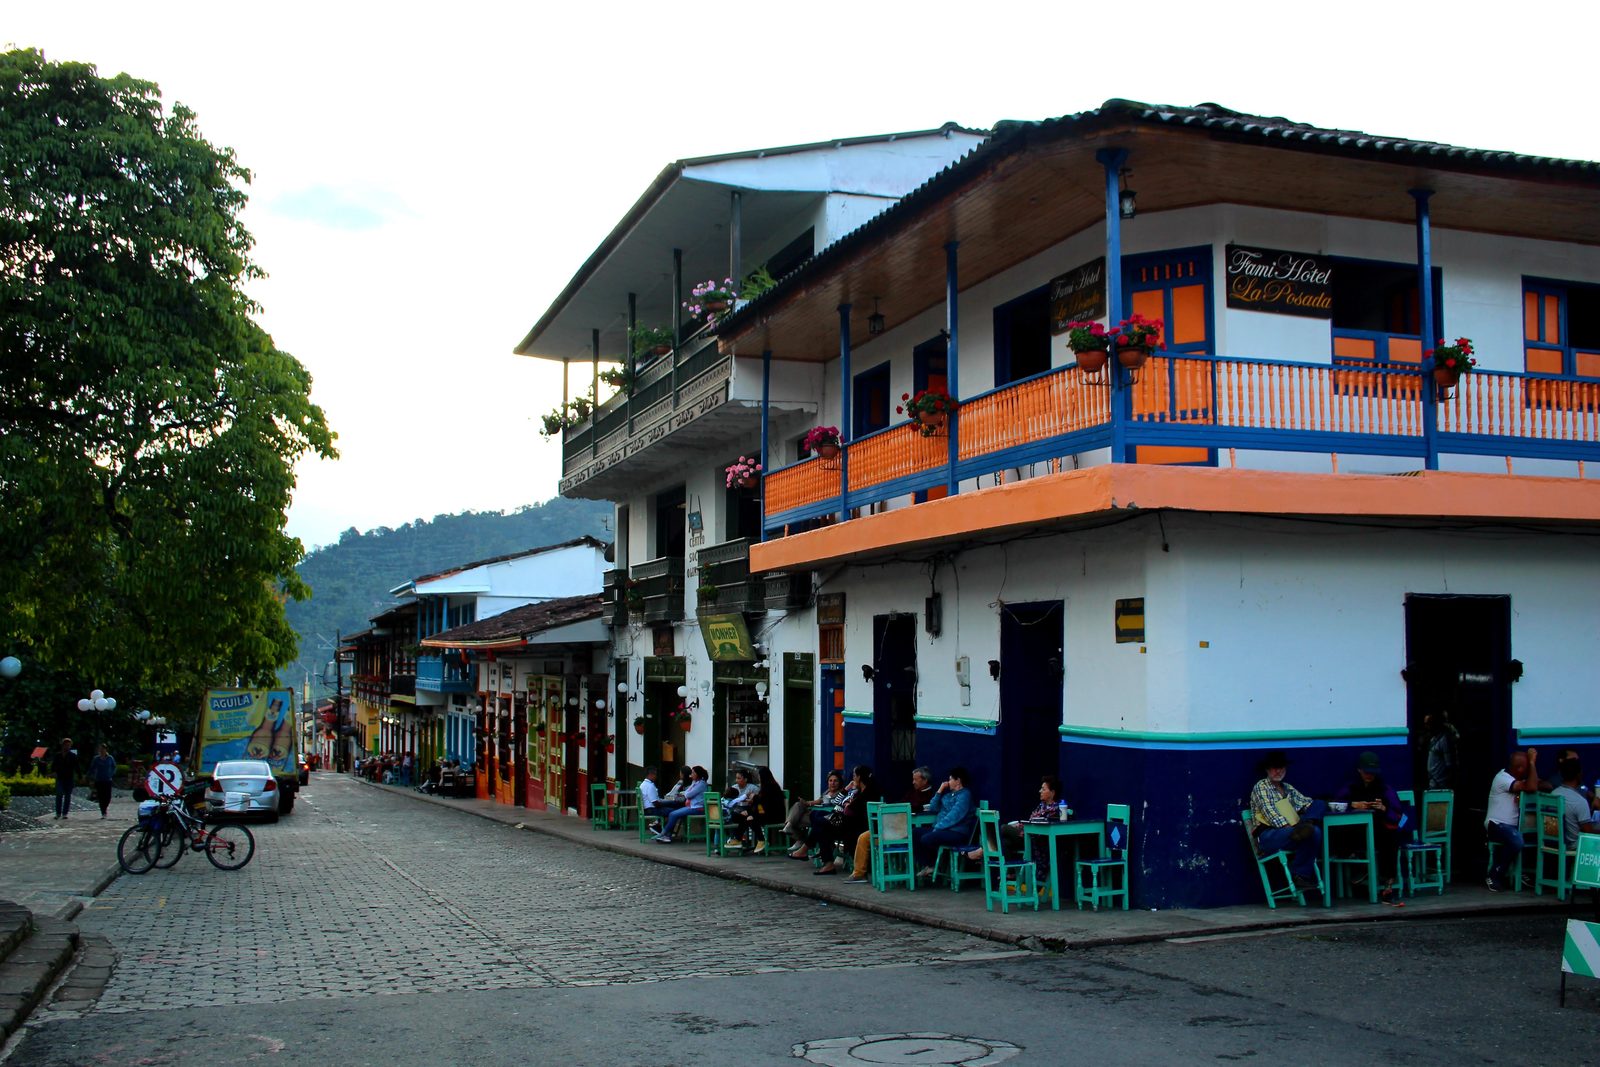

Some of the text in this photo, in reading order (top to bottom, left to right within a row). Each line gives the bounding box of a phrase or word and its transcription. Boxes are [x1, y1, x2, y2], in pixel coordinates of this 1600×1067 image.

[1228, 249, 1331, 285] Fami Hotel
[1231, 275, 1332, 308] La Posada
[689, 551, 698, 562] SOC
[213, 695, 250, 709] AGUILA
[158, 770, 175, 792] P
[1580, 853, 1600, 867] DEPA
